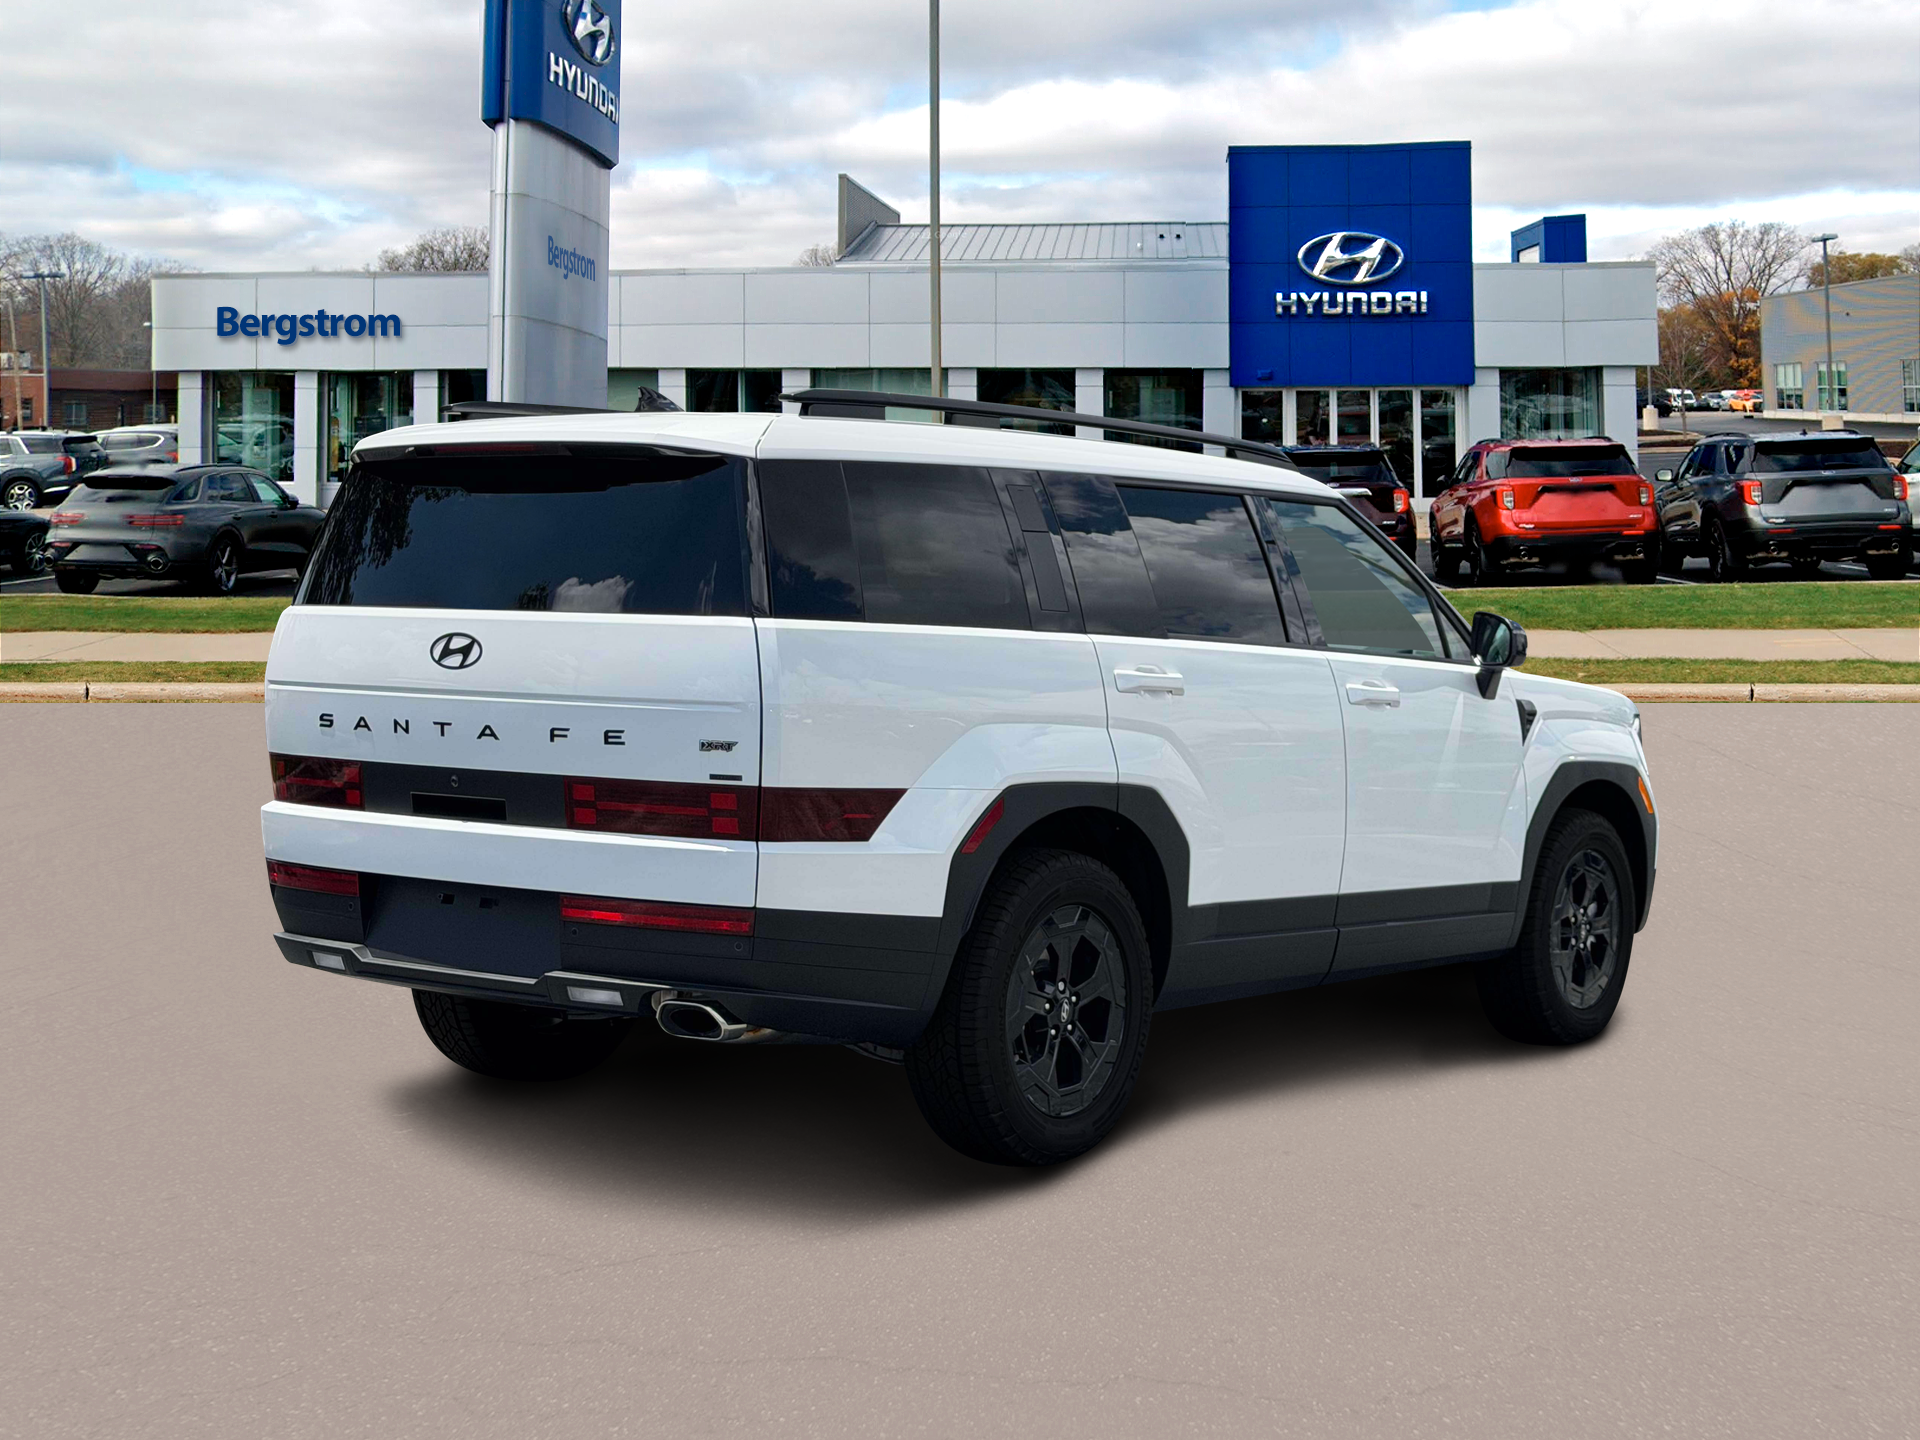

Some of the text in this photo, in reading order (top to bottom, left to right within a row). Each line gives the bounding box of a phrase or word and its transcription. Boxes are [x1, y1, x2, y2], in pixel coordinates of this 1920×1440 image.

[548, 51, 619, 125] HYUNDAI
[547, 234, 596, 282] Bergstrom
[1275, 291, 1428, 315] HYUNDAI
[216, 306, 402, 346] Bergstrom
[318, 712, 627, 747] SANTA FE
[700, 740, 739, 752] XRT
